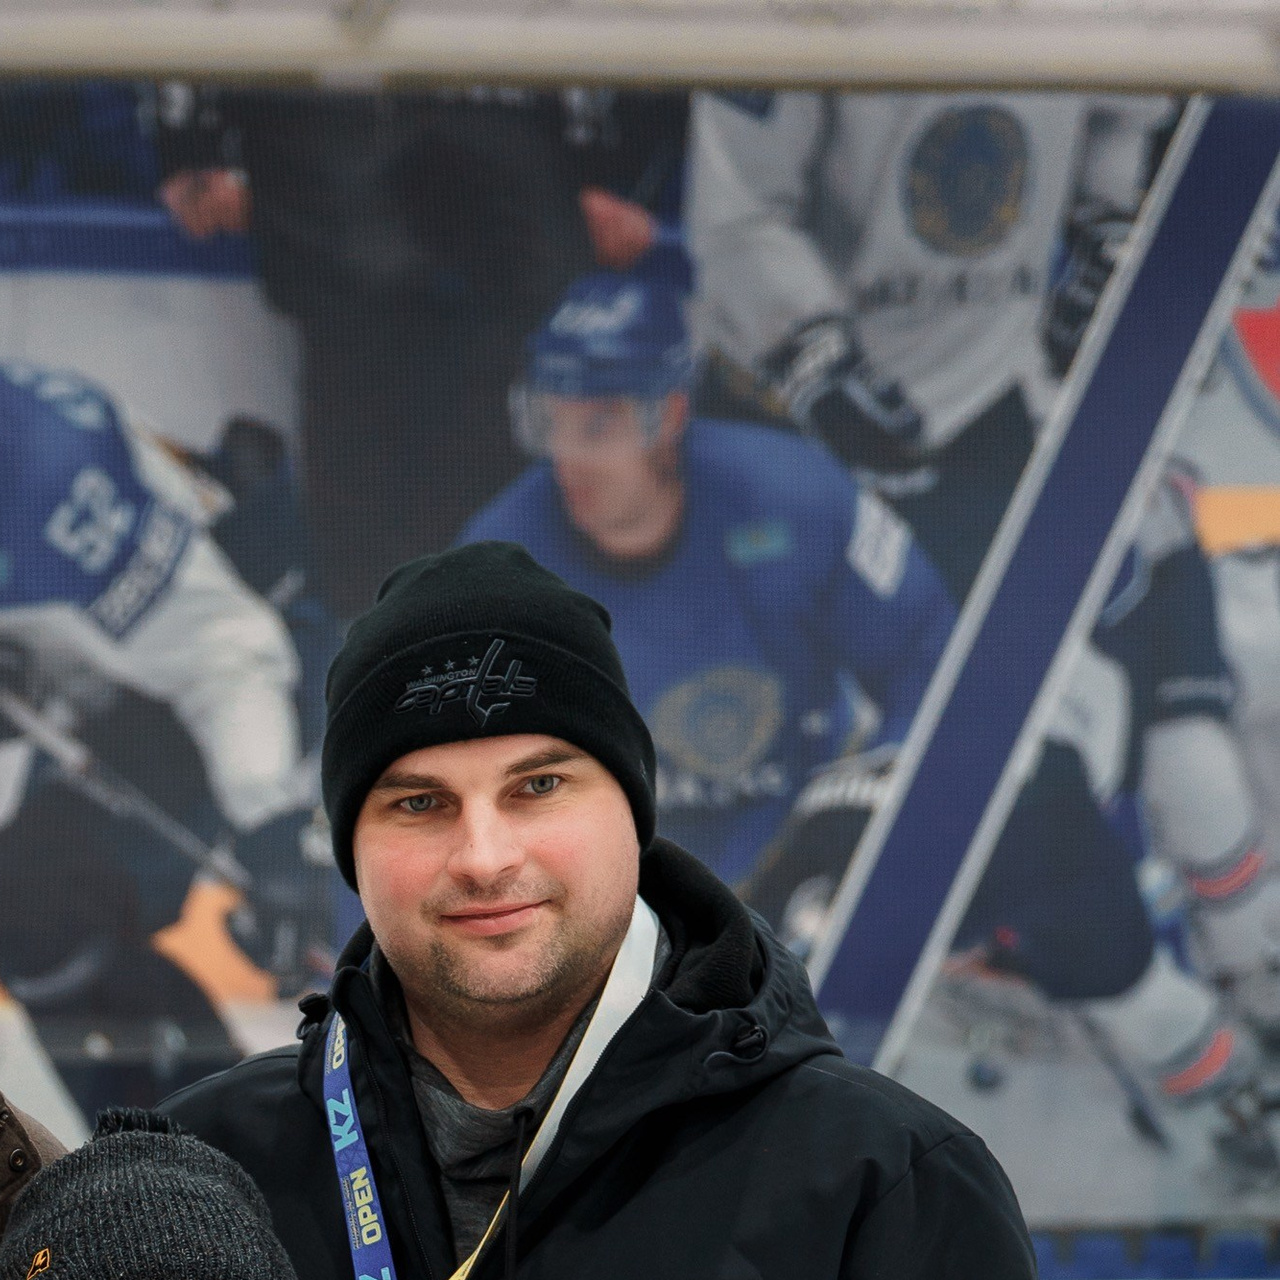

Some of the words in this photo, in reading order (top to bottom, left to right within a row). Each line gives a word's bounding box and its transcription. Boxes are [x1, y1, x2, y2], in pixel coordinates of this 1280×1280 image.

[406, 667, 478, 691] WASHINGTON
[326, 1088, 360, 1152] KZ
[349, 1166, 382, 1245] OPEN
